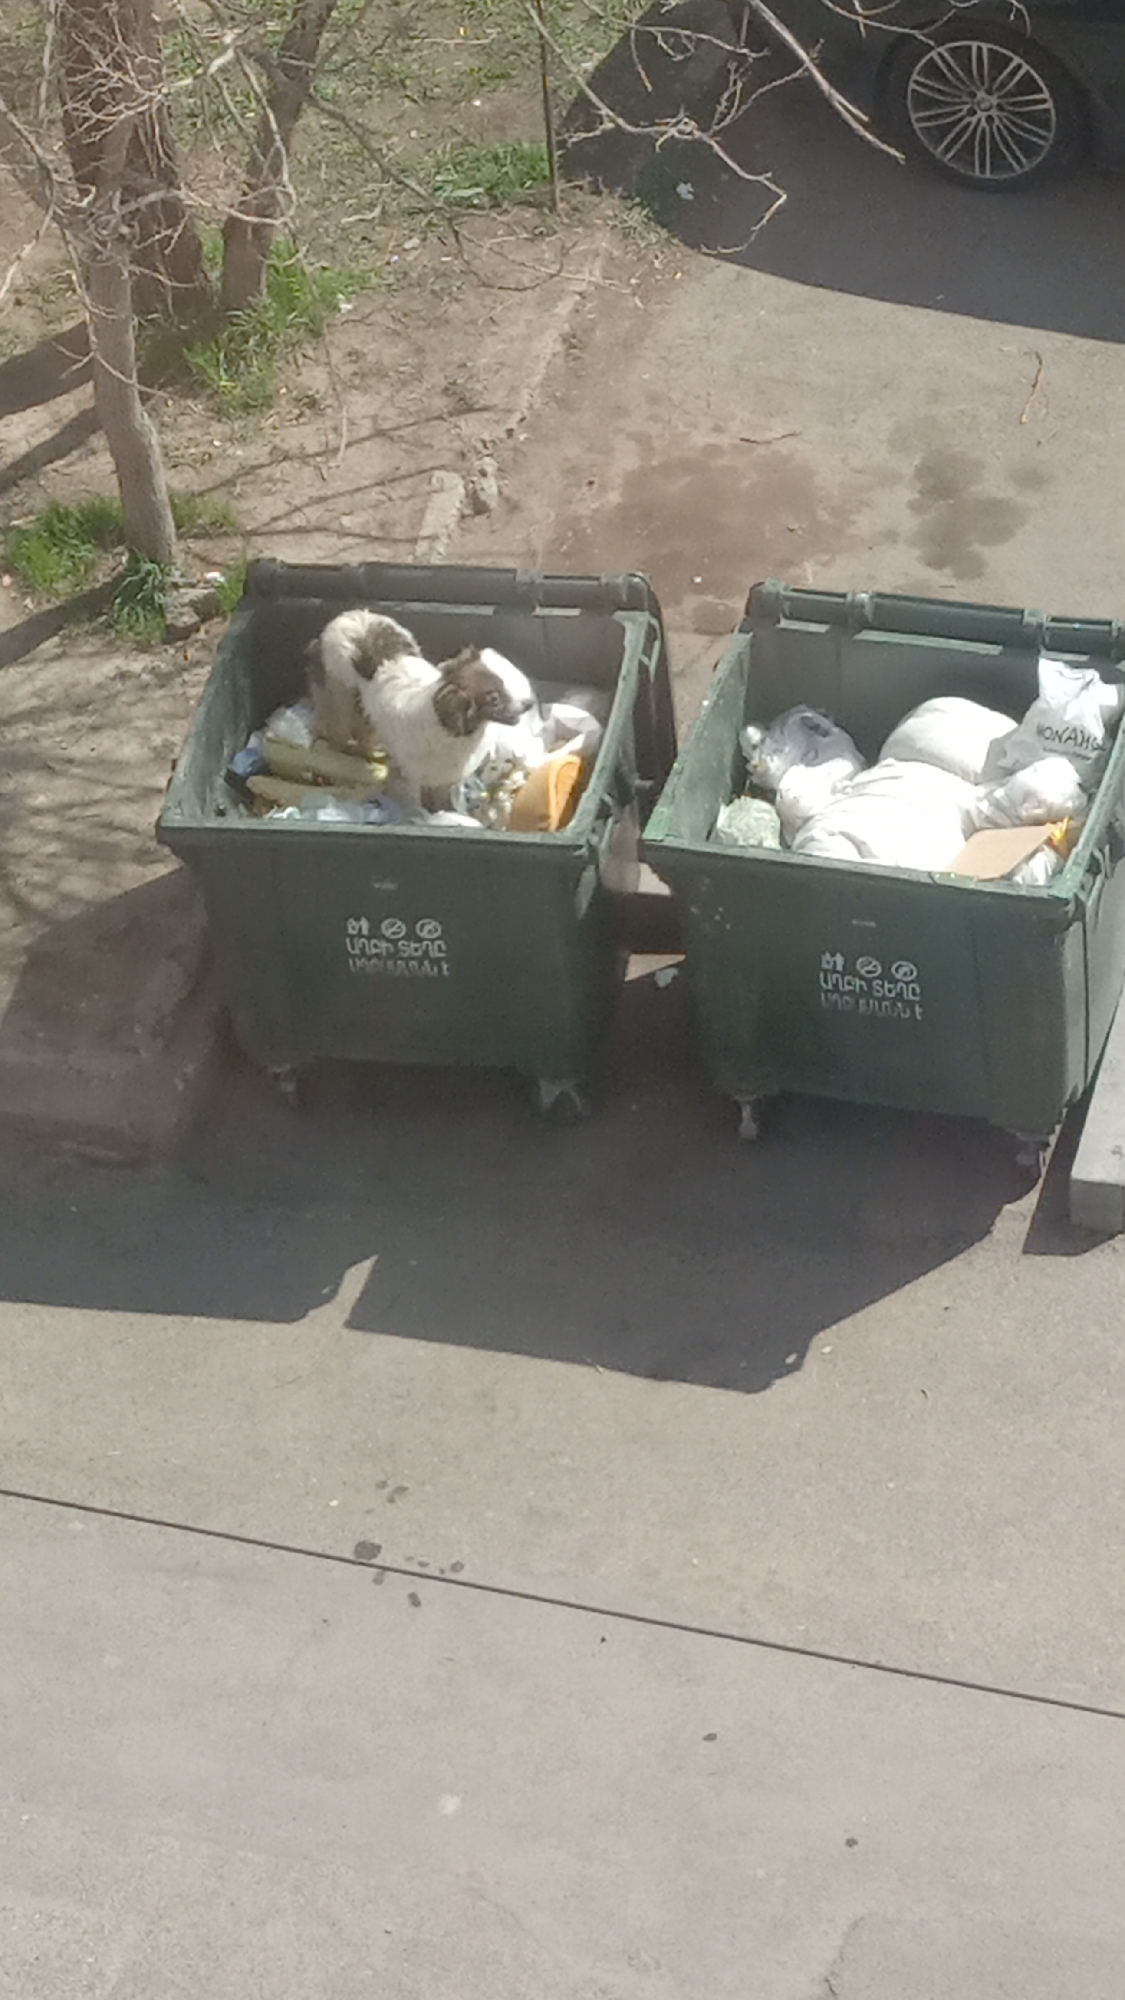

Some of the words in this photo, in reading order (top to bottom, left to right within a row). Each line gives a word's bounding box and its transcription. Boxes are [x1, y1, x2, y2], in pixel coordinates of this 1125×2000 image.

[345, 937, 395, 956] ԱՂԲԻ
[397, 940, 447, 958] ՏԵՂԸ
[819, 971, 867, 993] ԱՂԲԻ
[871, 979, 921, 1001] ՏԵՂԸ
